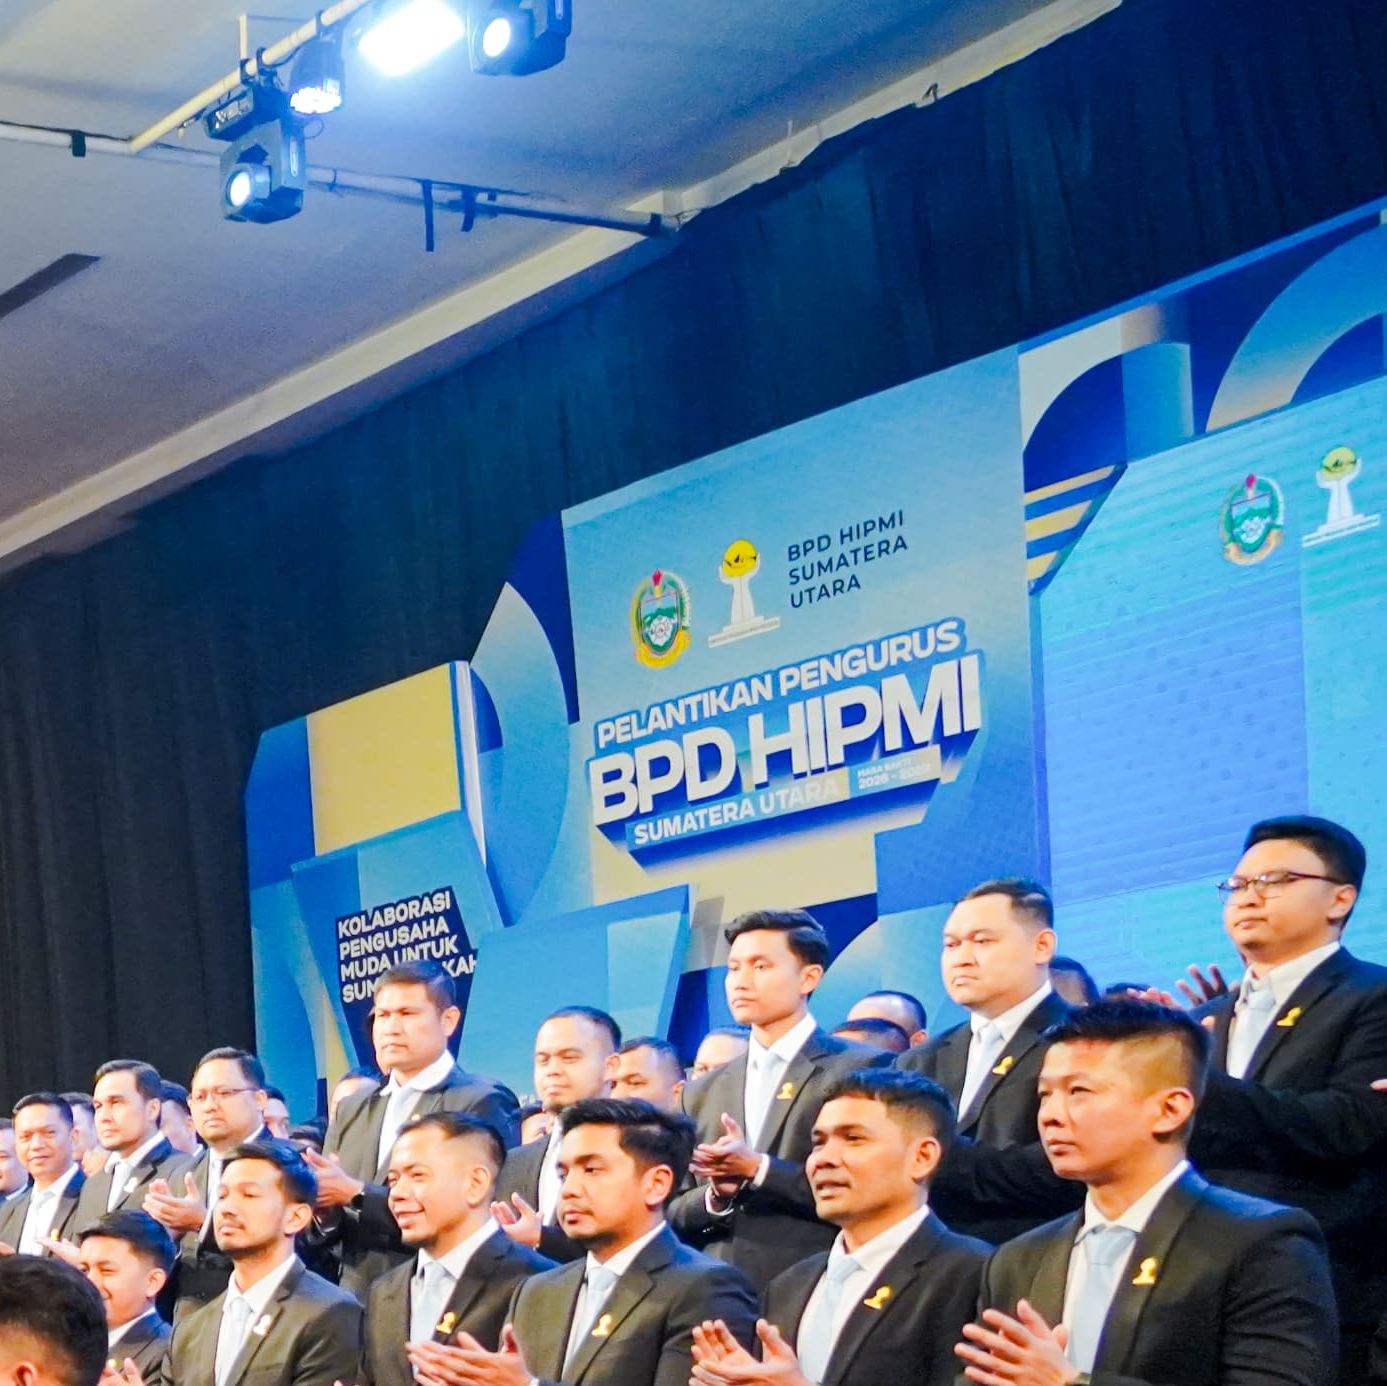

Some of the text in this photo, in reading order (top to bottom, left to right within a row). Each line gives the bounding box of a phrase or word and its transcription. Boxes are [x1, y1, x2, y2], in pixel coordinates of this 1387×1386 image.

[787, 509, 904, 562] BPD HIPMI
[788, 535, 908, 586] SUMATERA
[790, 573, 861, 609] UTARA
[597, 673, 773, 749] PELANTIKAN
[778, 621, 962, 697] PENGURUS
[588, 654, 983, 825] BPD HIPMI
[632, 776, 840, 846] SUMATERA UTARA
[337, 890, 452, 940] KOLABORASI
[339, 915, 450, 961] PENGUSAHA
[340, 953, 392, 982] MUDA
